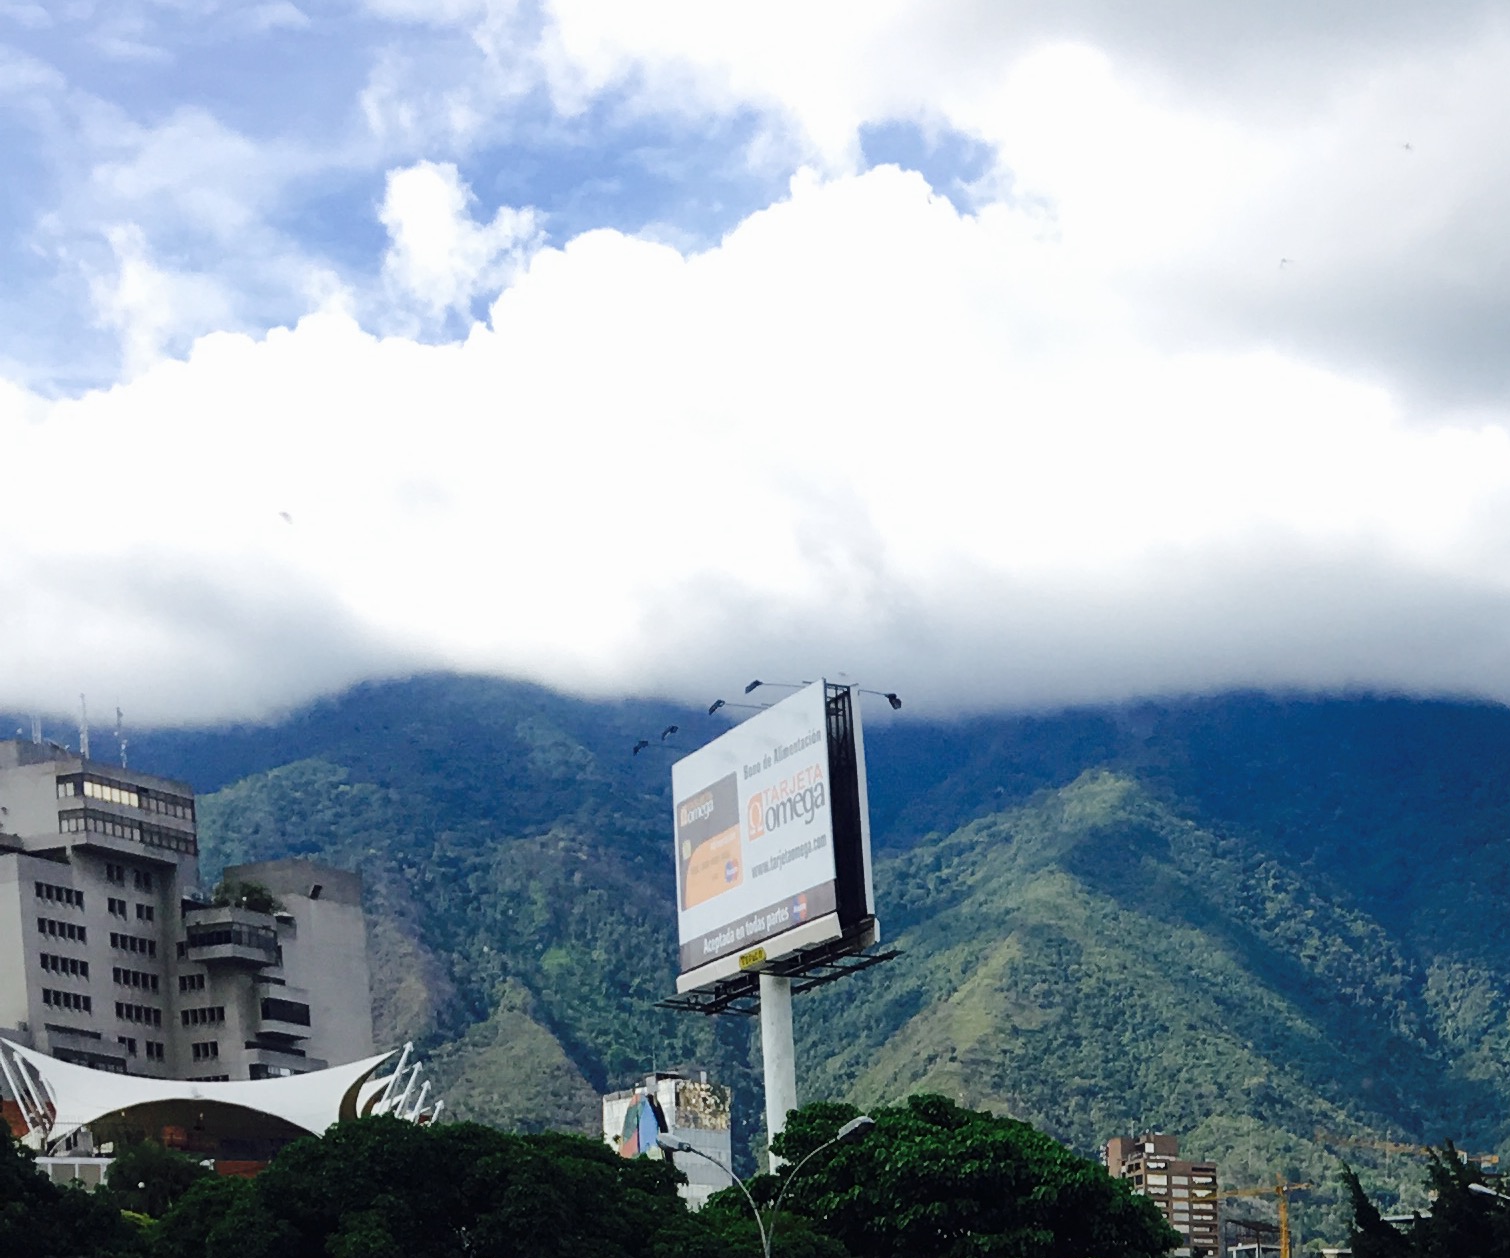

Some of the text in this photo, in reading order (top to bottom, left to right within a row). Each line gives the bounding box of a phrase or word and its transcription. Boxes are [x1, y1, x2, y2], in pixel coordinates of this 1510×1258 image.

[743, 728, 822, 780] Bono de Alimentación
[762, 763, 823, 806] TARJETA
[765, 781, 826, 833] omega
[751, 833, 828, 879] www.tarjetaomega.com
[703, 906, 790, 955] Aceptada en todas partes
